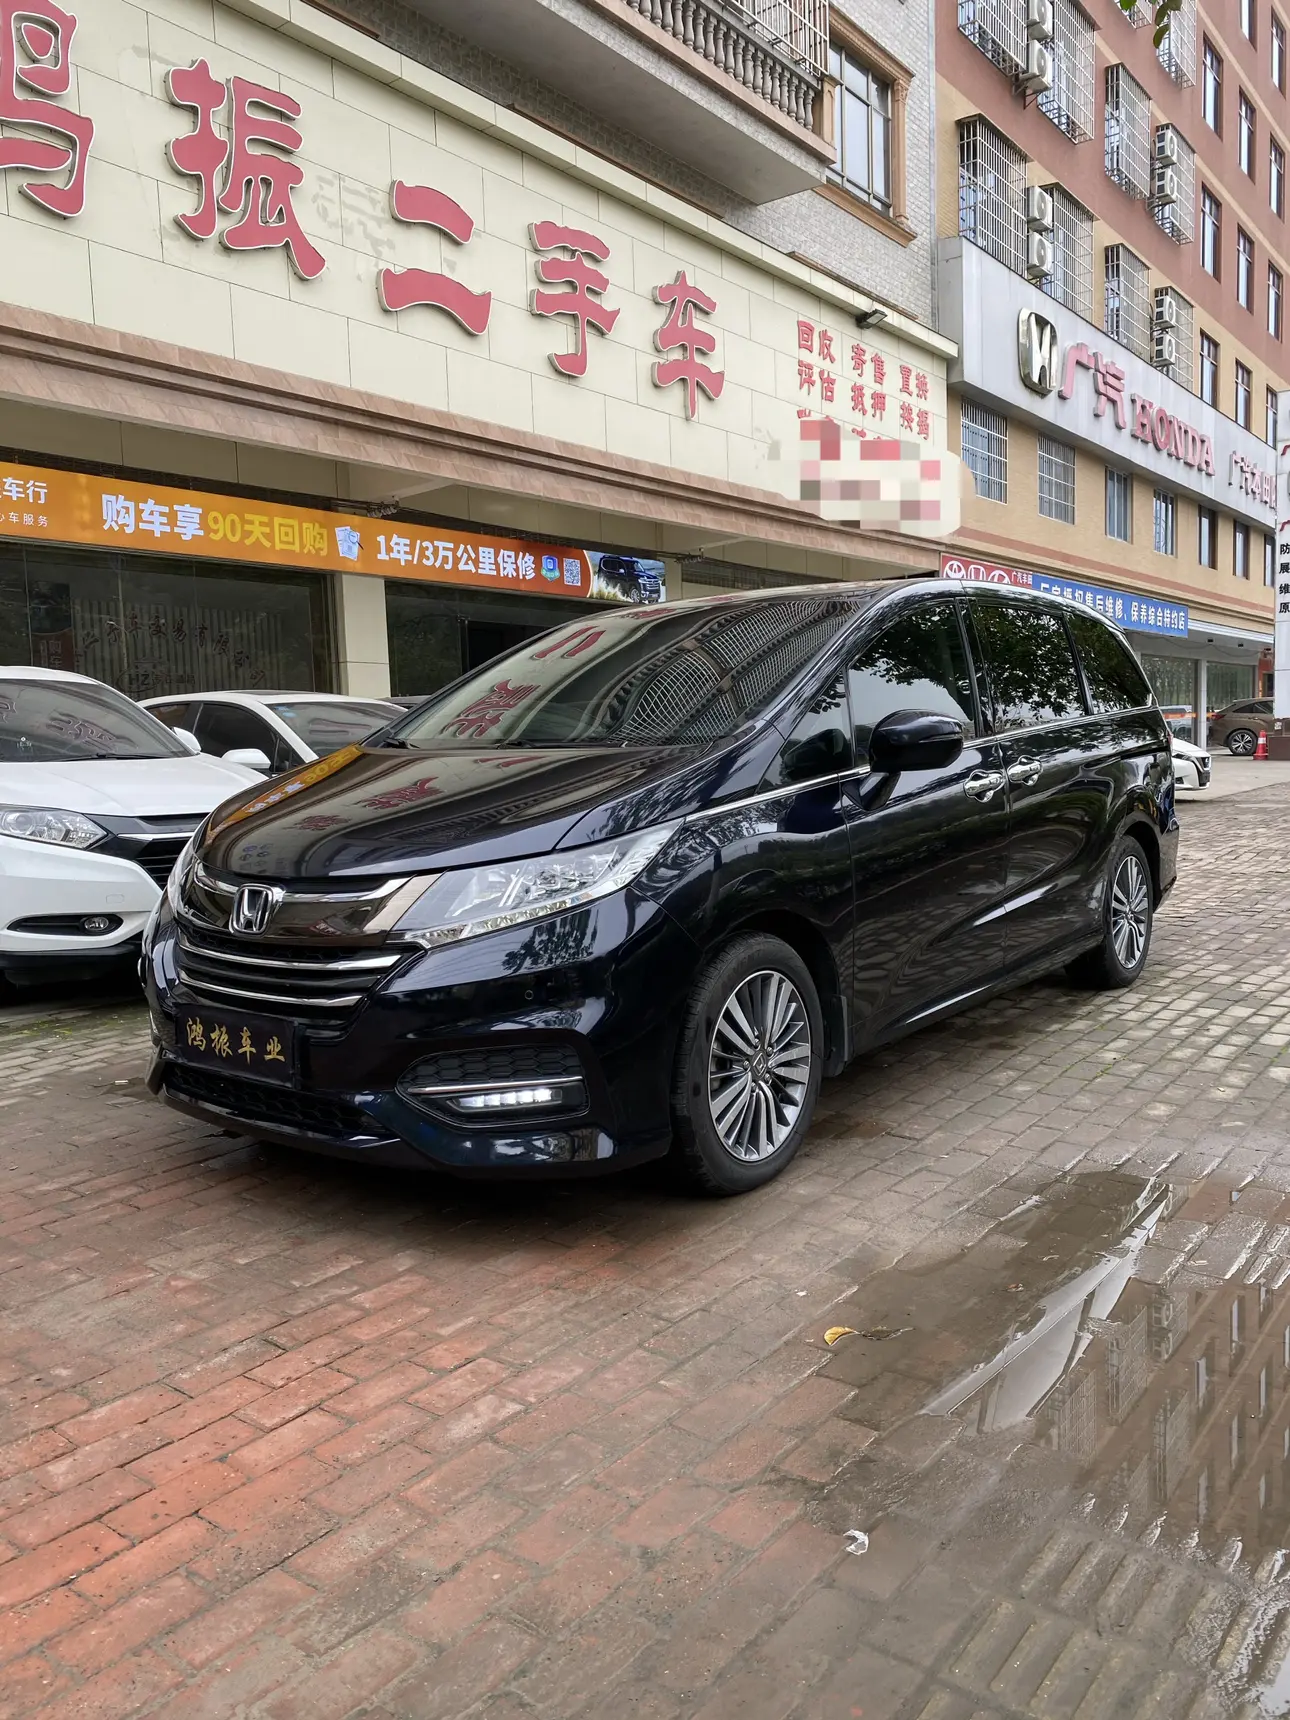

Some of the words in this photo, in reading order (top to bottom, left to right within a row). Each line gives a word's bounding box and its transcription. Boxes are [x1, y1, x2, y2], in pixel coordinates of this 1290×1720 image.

[797, 320, 836, 364] 回收
[851, 343, 887, 385] 寄售
[899, 365, 930, 401] 置换
[798, 360, 837, 402] 评估
[851, 382, 887, 421] 抵押
[900, 401, 930, 440] 按揭
[1058, 342, 1127, 430] 广汽
[1130, 393, 1216, 477] HONDA
[0, 477, 48, 504] 车行
[102, 493, 329, 557] 购车享90天回购
[376, 533, 537, 581] 1年/3万公里保修
[186, 1016, 287, 1063] 鸿振车业
